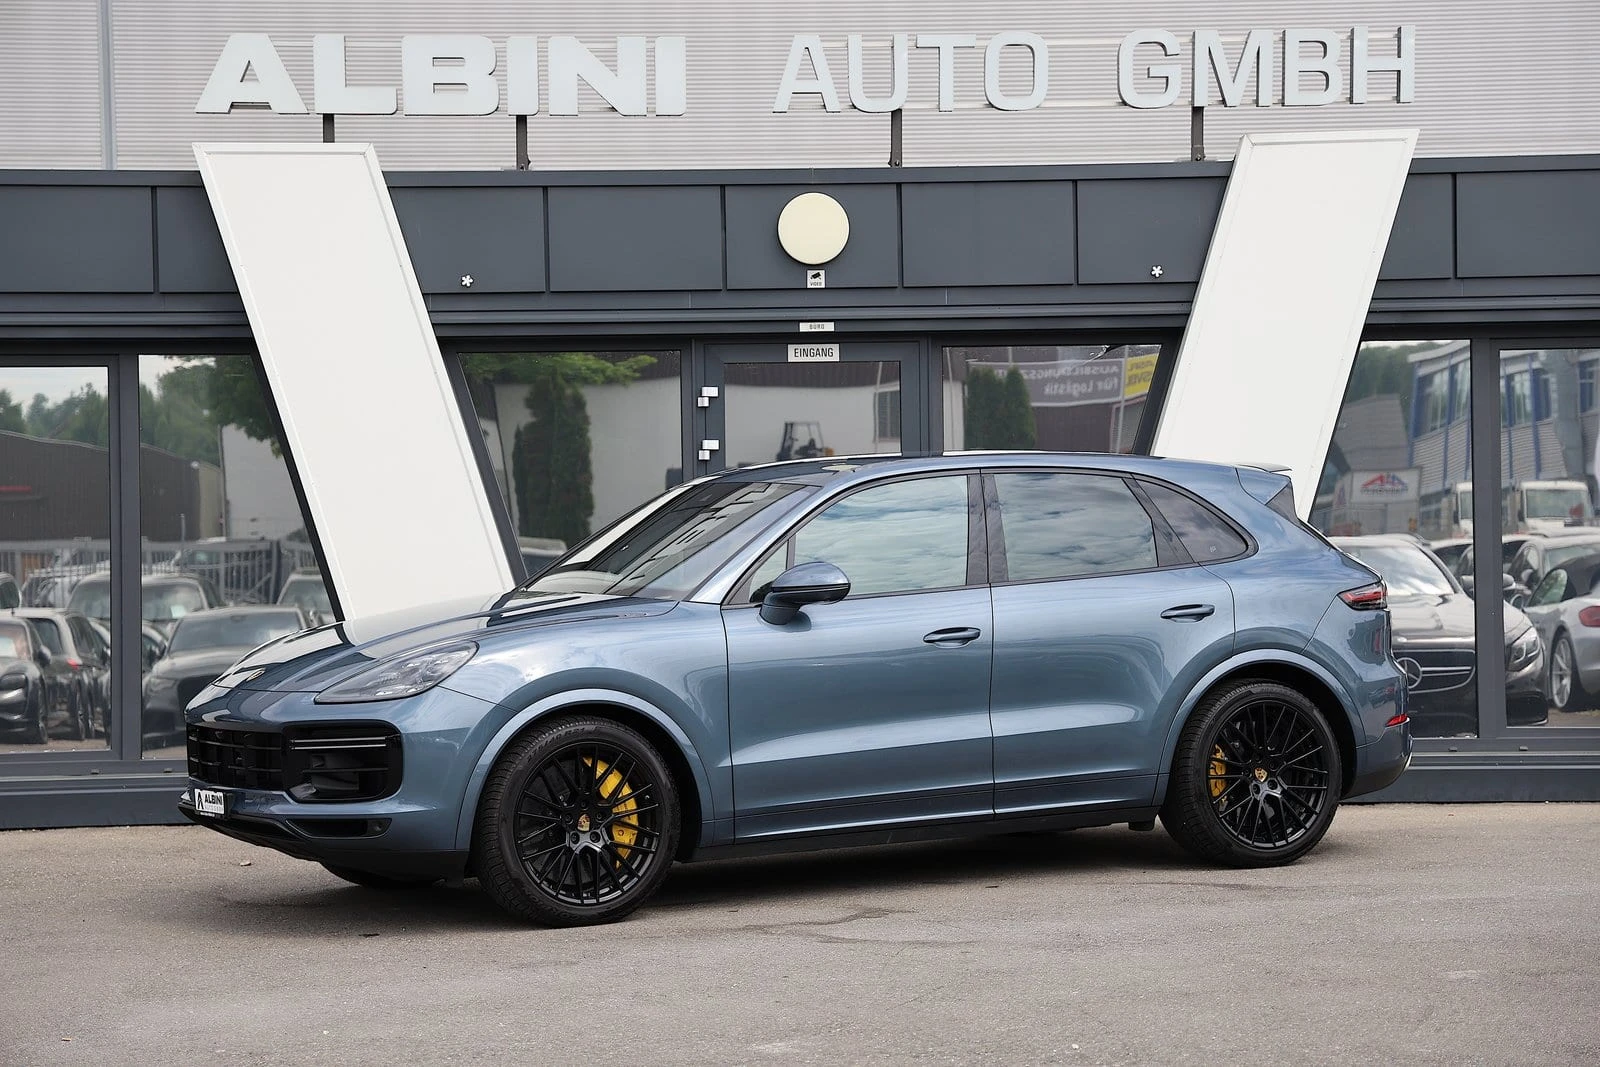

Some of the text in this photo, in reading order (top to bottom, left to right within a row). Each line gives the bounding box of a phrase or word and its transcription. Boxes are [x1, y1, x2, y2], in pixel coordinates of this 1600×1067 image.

[195, 25, 1416, 116] ALBINI AUTO GMBH
[794, 347, 834, 358] EINGANG
[204, 793, 223, 806] ALBINI
